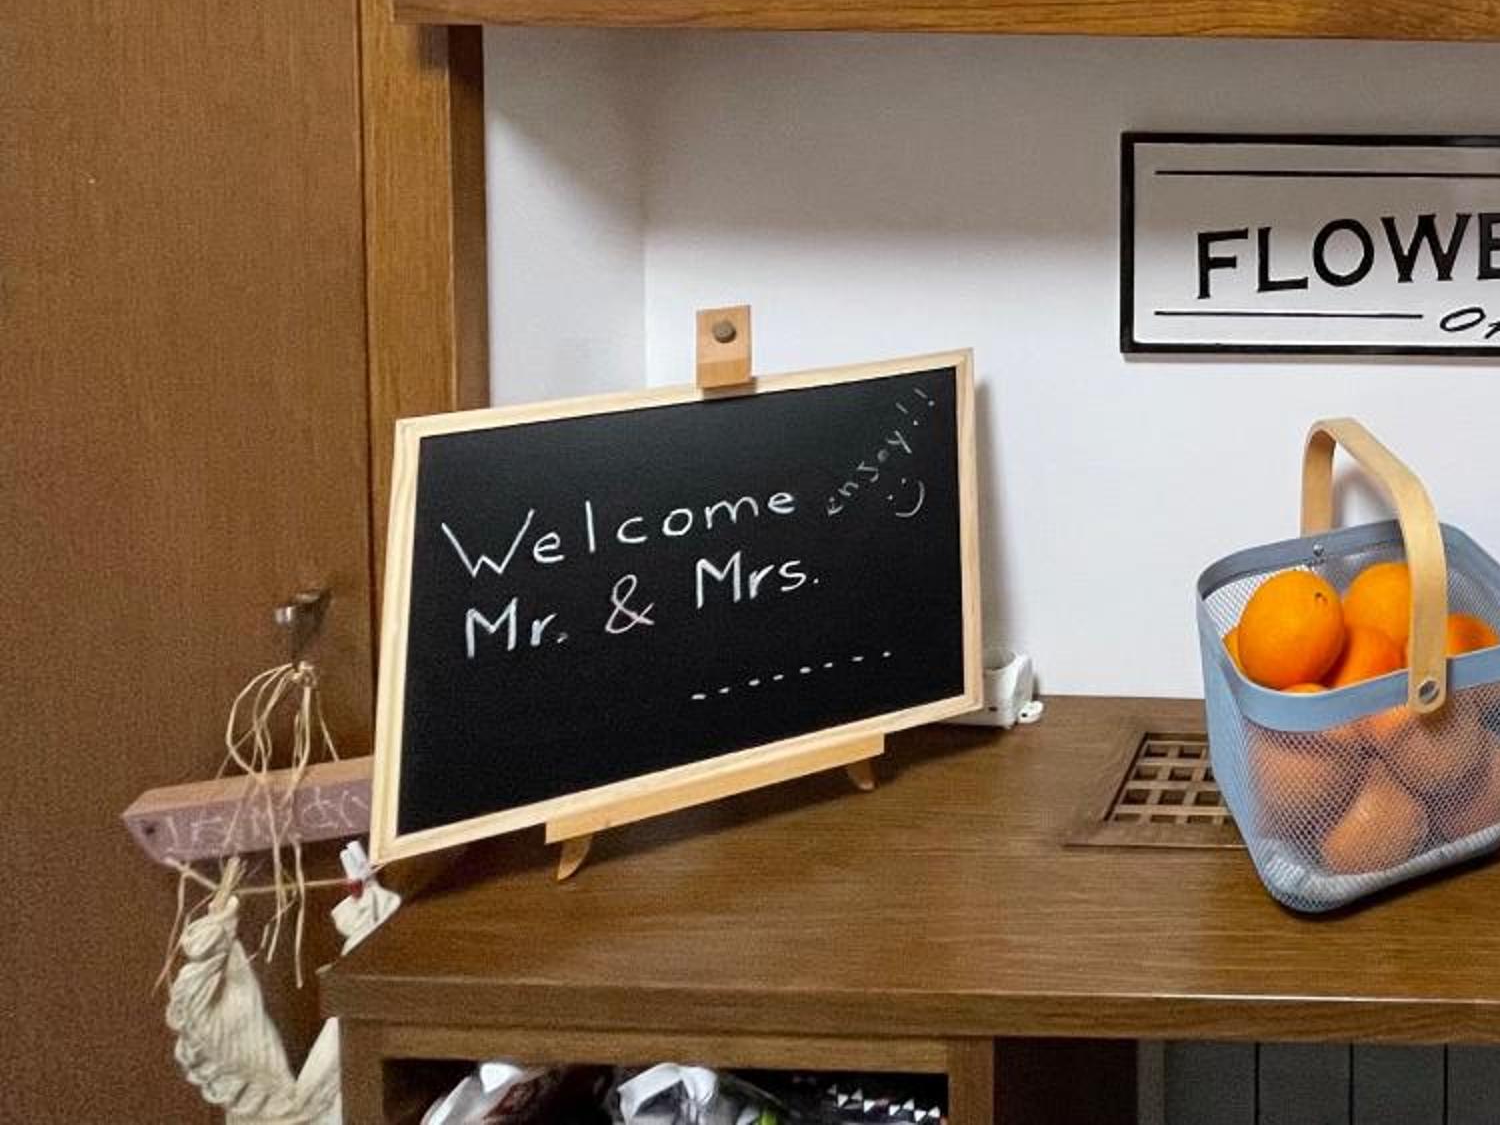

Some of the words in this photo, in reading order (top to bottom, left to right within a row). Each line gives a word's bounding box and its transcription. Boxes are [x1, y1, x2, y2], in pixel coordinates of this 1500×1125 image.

[440, 490, 797, 578] Welcome
[464, 596, 568, 658] Mr.
[604, 573, 656, 636] &
[694, 550, 821, 610] Mrs.
